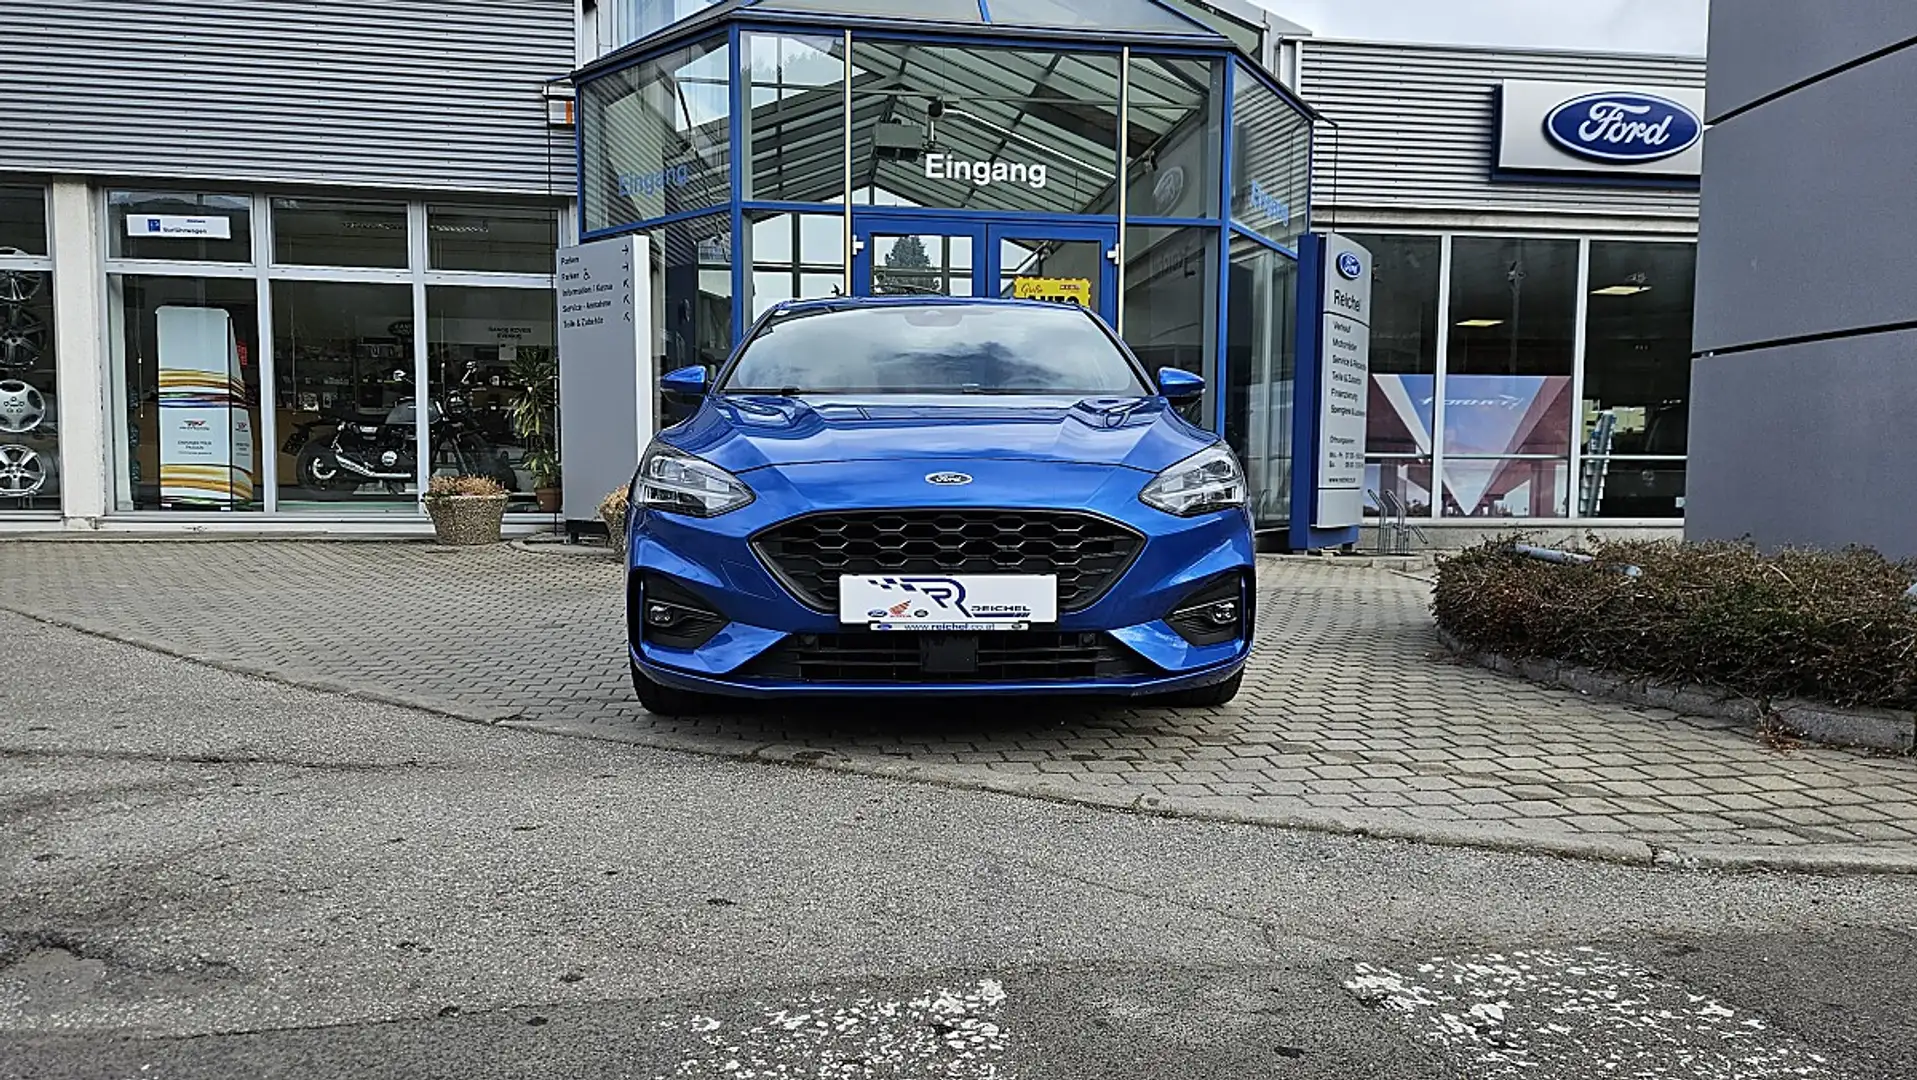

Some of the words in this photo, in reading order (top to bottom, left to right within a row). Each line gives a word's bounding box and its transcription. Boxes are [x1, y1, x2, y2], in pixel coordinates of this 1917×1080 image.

[1577, 101, 1674, 146] Ford
[618, 164, 688, 197] Eingang
[925, 153, 1046, 188] Eingang
[1251, 180, 1289, 227] Eingang
[561, 256, 580, 265] Parken
